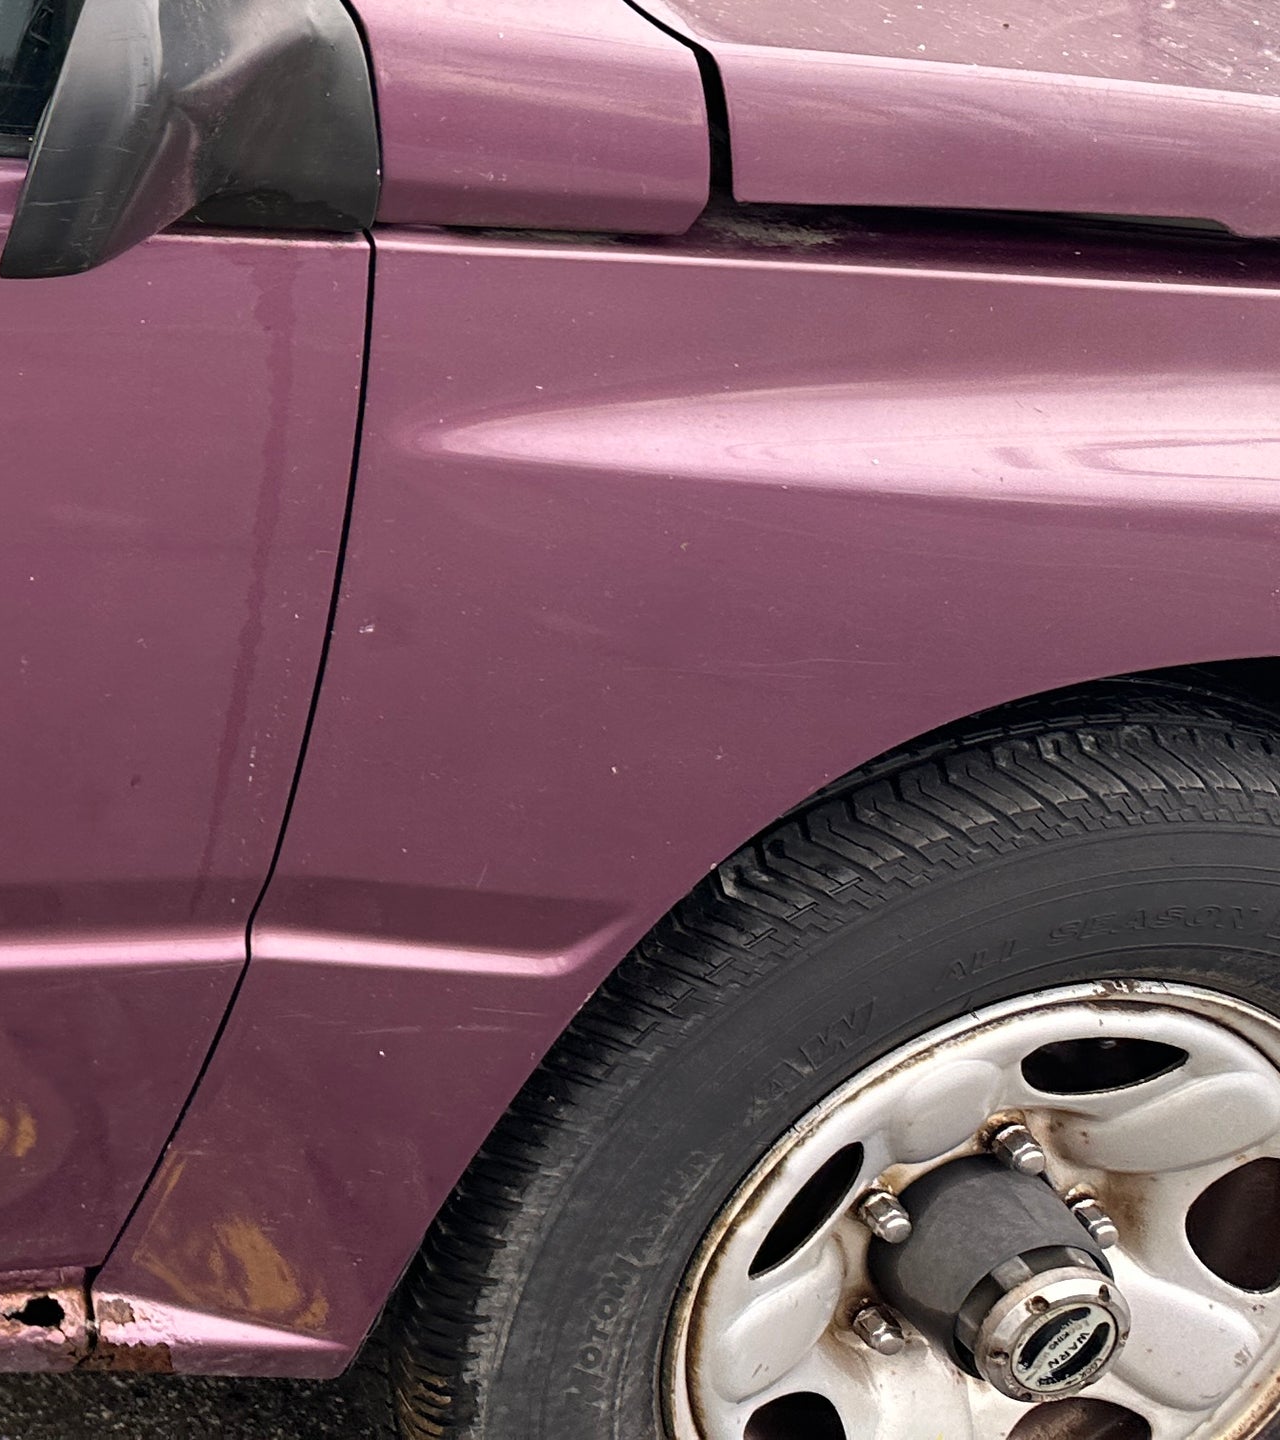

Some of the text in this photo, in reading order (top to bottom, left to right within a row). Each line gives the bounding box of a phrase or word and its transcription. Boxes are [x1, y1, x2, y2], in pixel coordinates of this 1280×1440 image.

[945, 937, 1034, 984] ALL
[1046, 905, 1261, 946] SEASON
[1047, 1331, 1091, 1369] WARN
